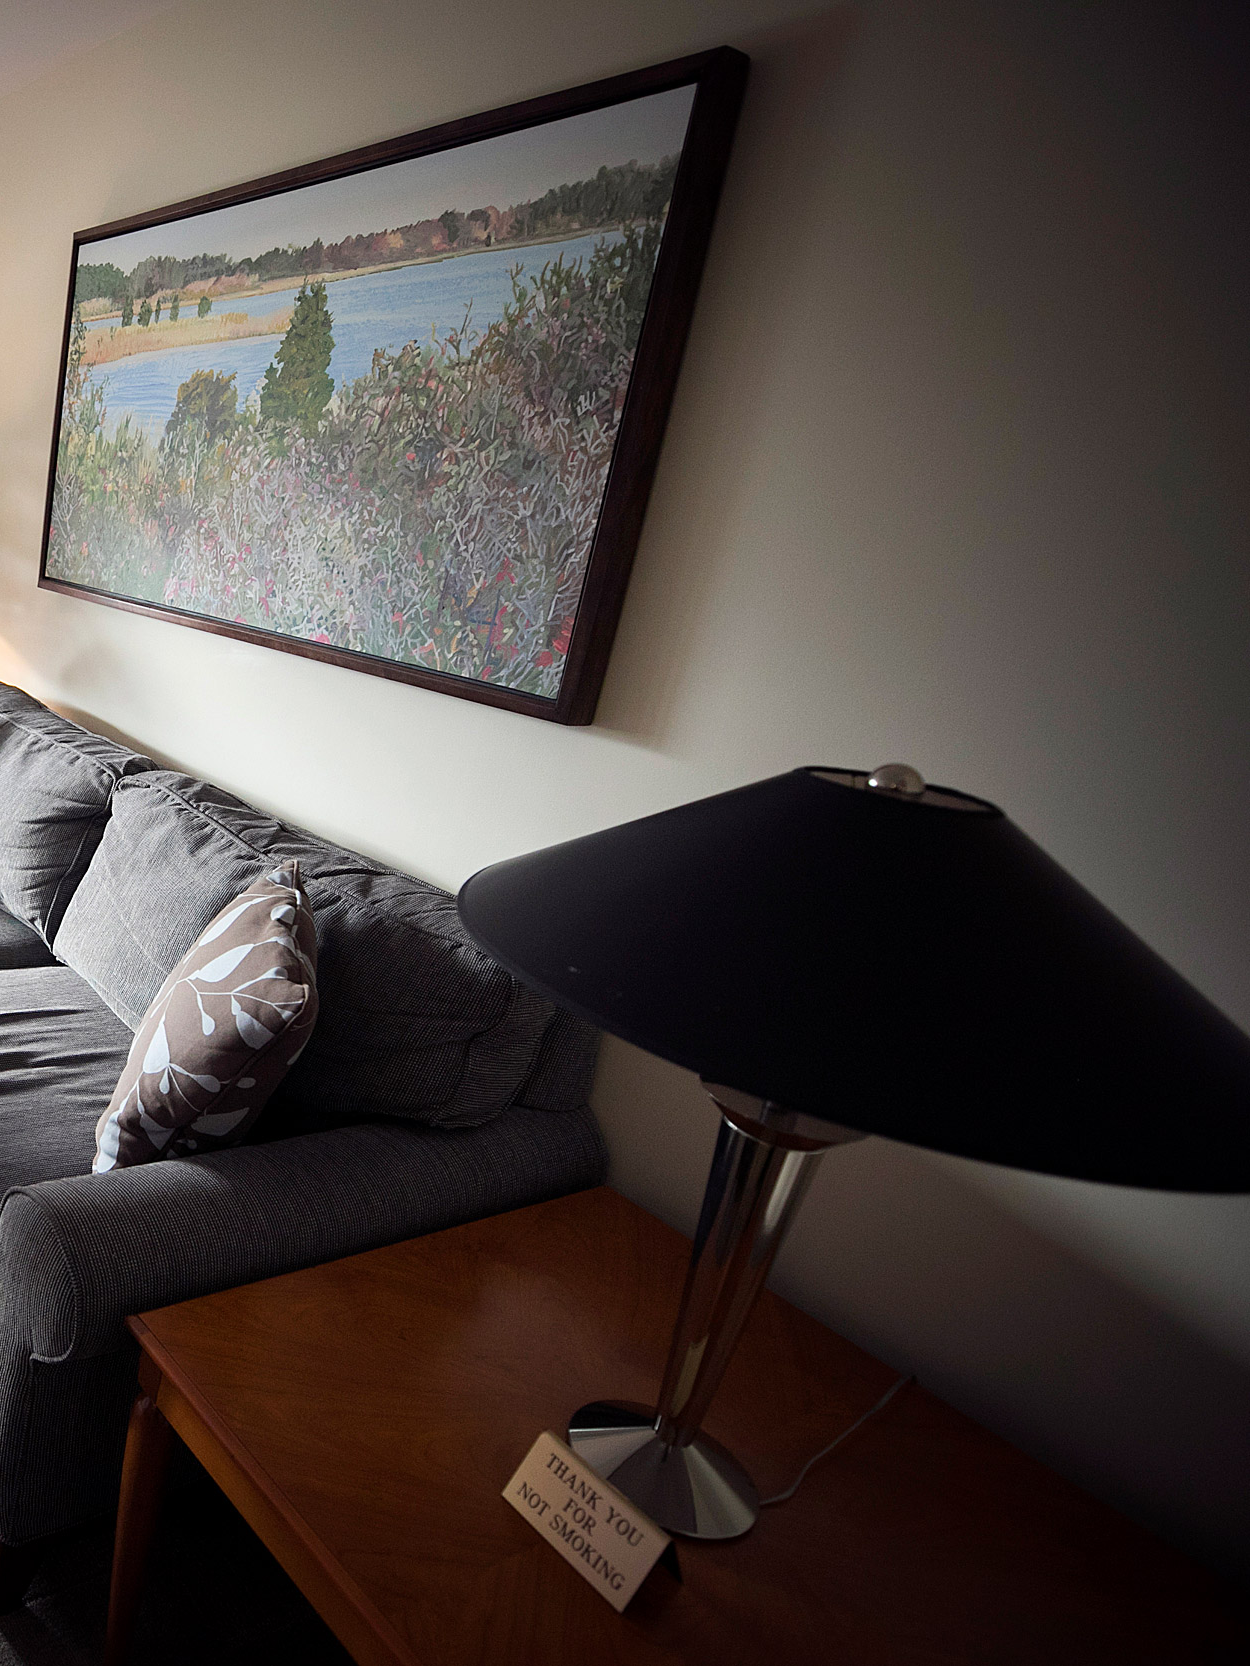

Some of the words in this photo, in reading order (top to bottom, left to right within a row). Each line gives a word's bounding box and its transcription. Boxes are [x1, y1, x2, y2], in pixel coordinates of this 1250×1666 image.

[517, 1481, 551, 1516] NOT
[549, 1515, 625, 1591] SMOKING
[547, 1453, 603, 1511] THANK
[606, 1507, 644, 1546] YOU
[563, 1498, 597, 1536] FOR
